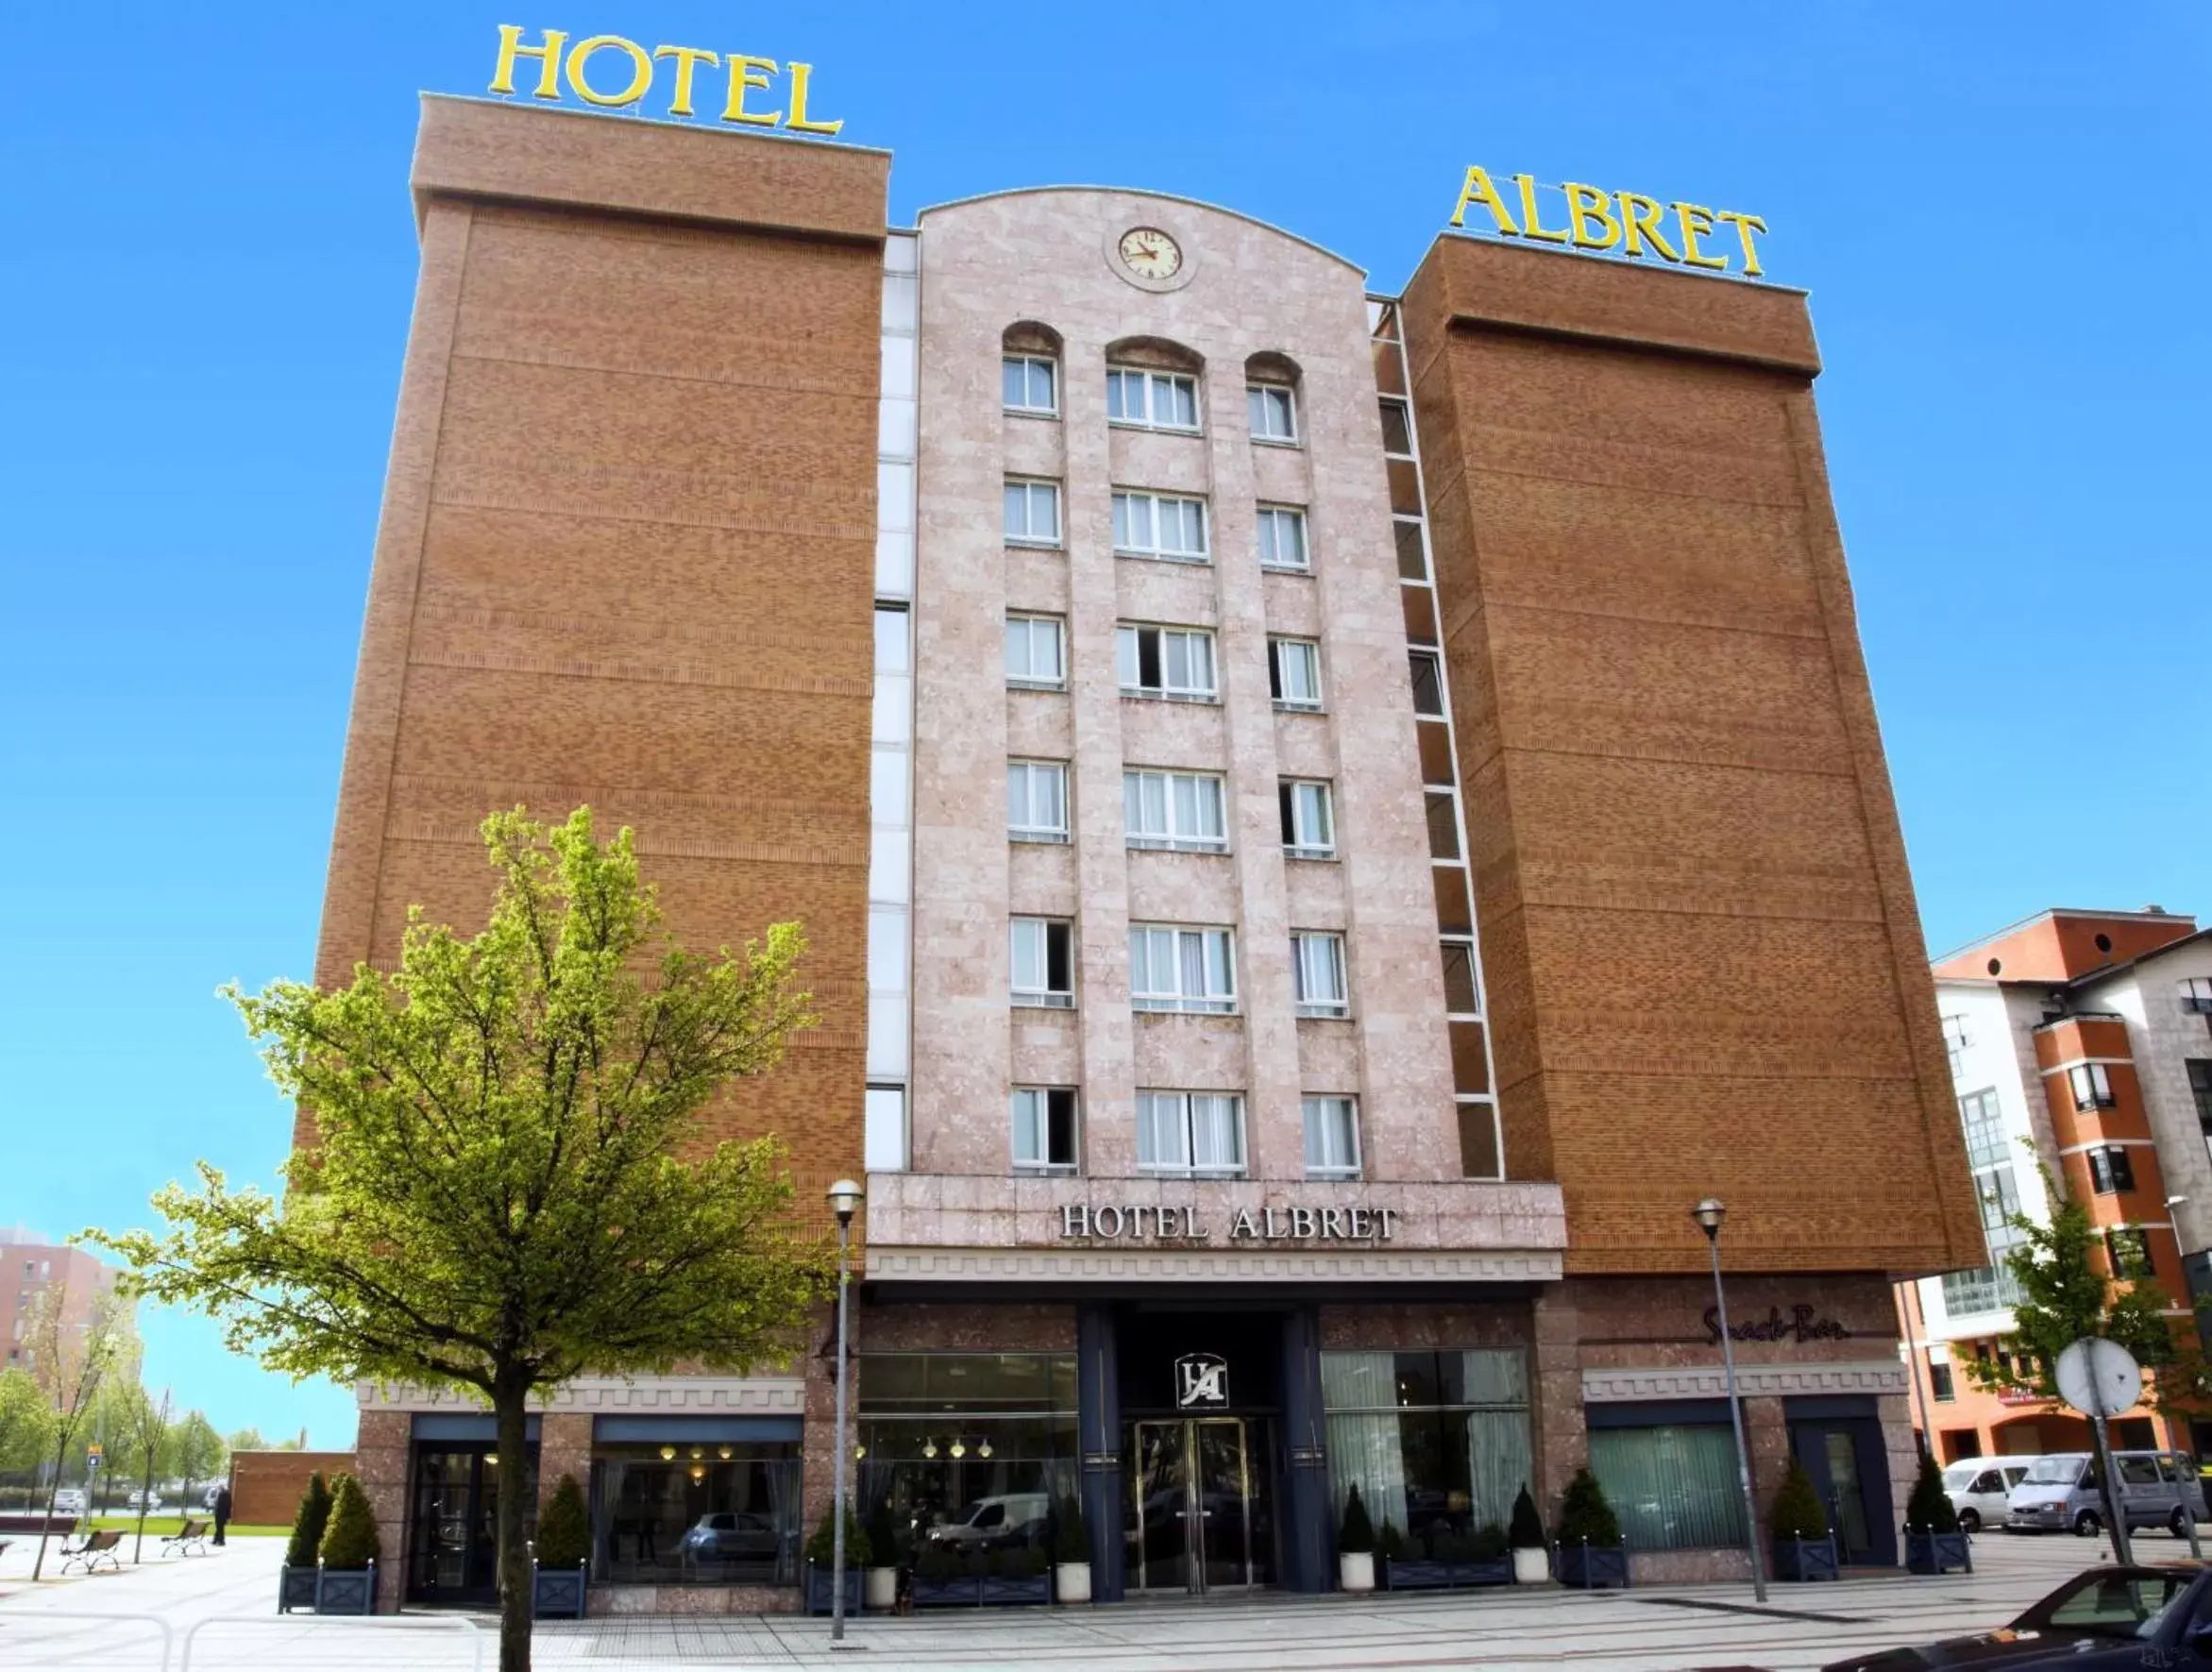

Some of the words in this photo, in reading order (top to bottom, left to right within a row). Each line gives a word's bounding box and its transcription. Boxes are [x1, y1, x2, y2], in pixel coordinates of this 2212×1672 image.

[488, 24, 844, 135] HOTEL
[1449, 165, 1767, 277] ALBRET
[1060, 1205, 1209, 1239] HOTEL
[1230, 1208, 1397, 1240] ALBRET
